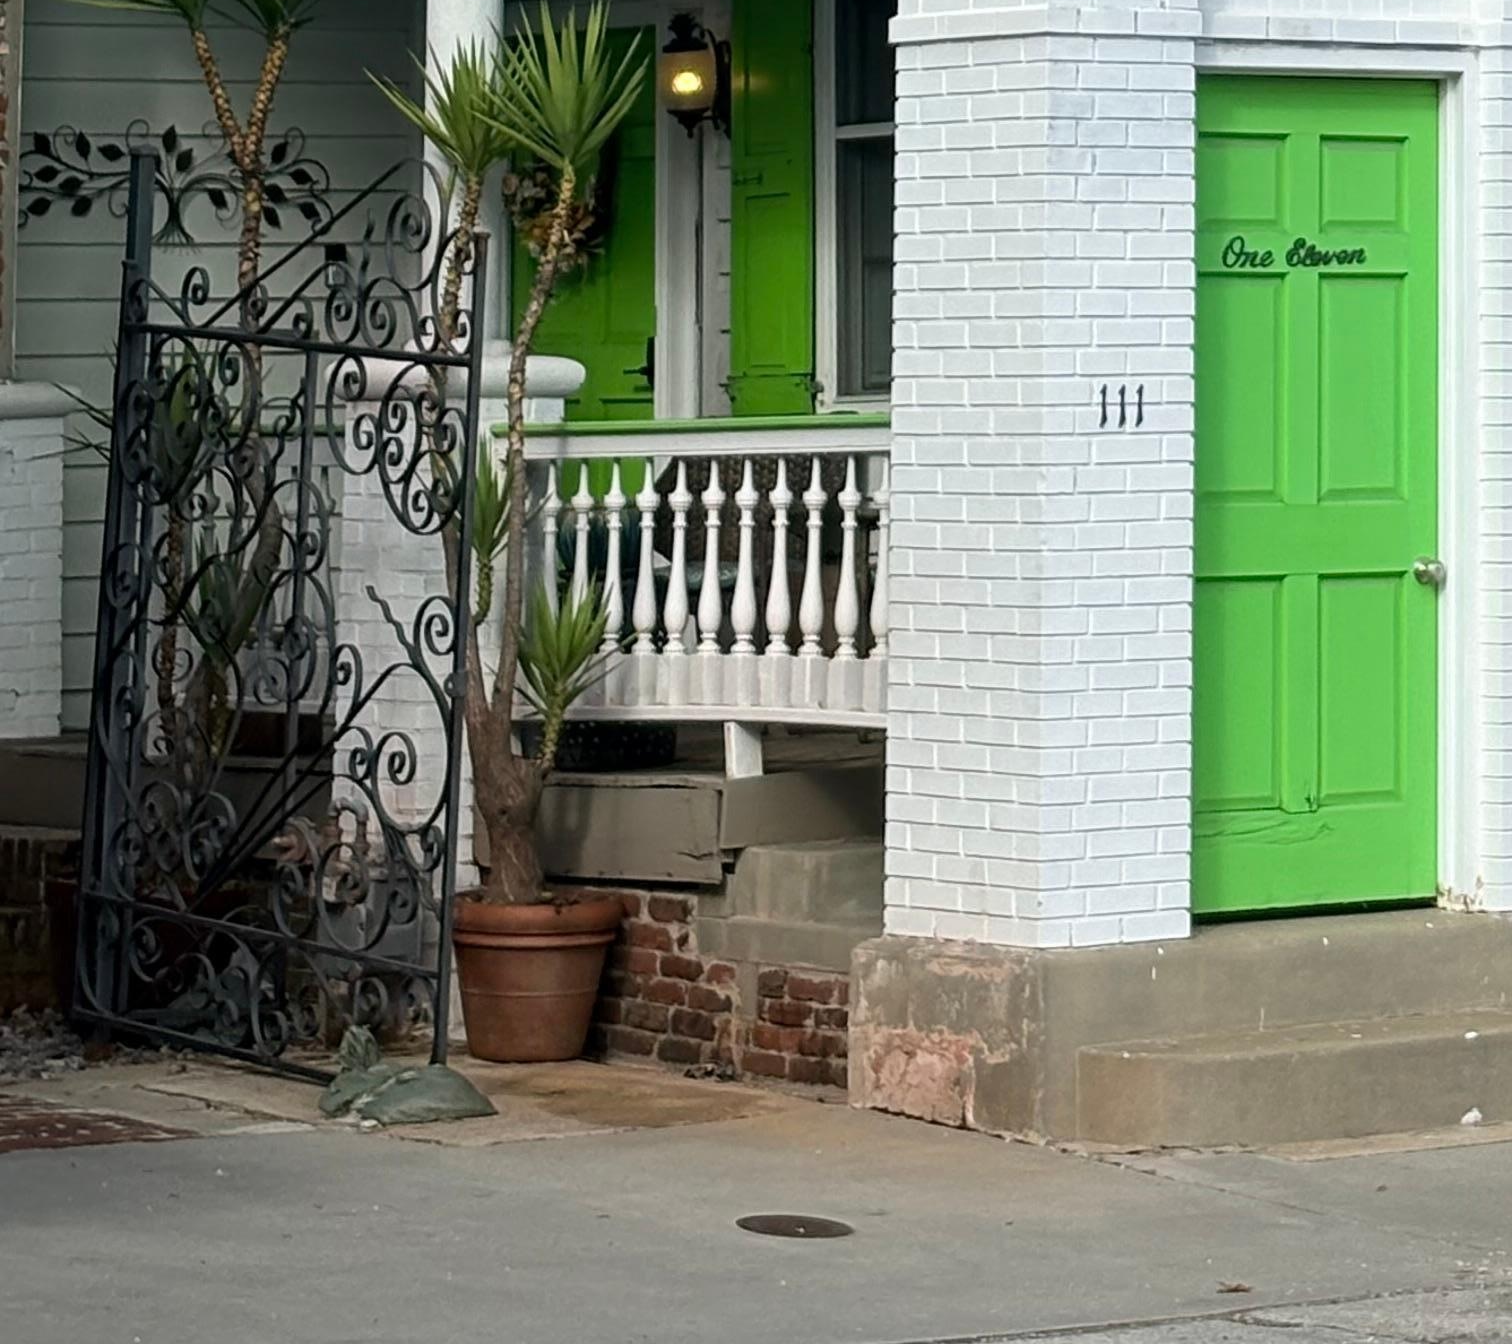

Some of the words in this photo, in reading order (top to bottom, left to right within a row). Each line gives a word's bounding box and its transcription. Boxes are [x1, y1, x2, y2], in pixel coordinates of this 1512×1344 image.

[1221, 235, 1275, 268] One
[1285, 237, 1367, 267] Eleven
[1099, 383, 1144, 428] 111
